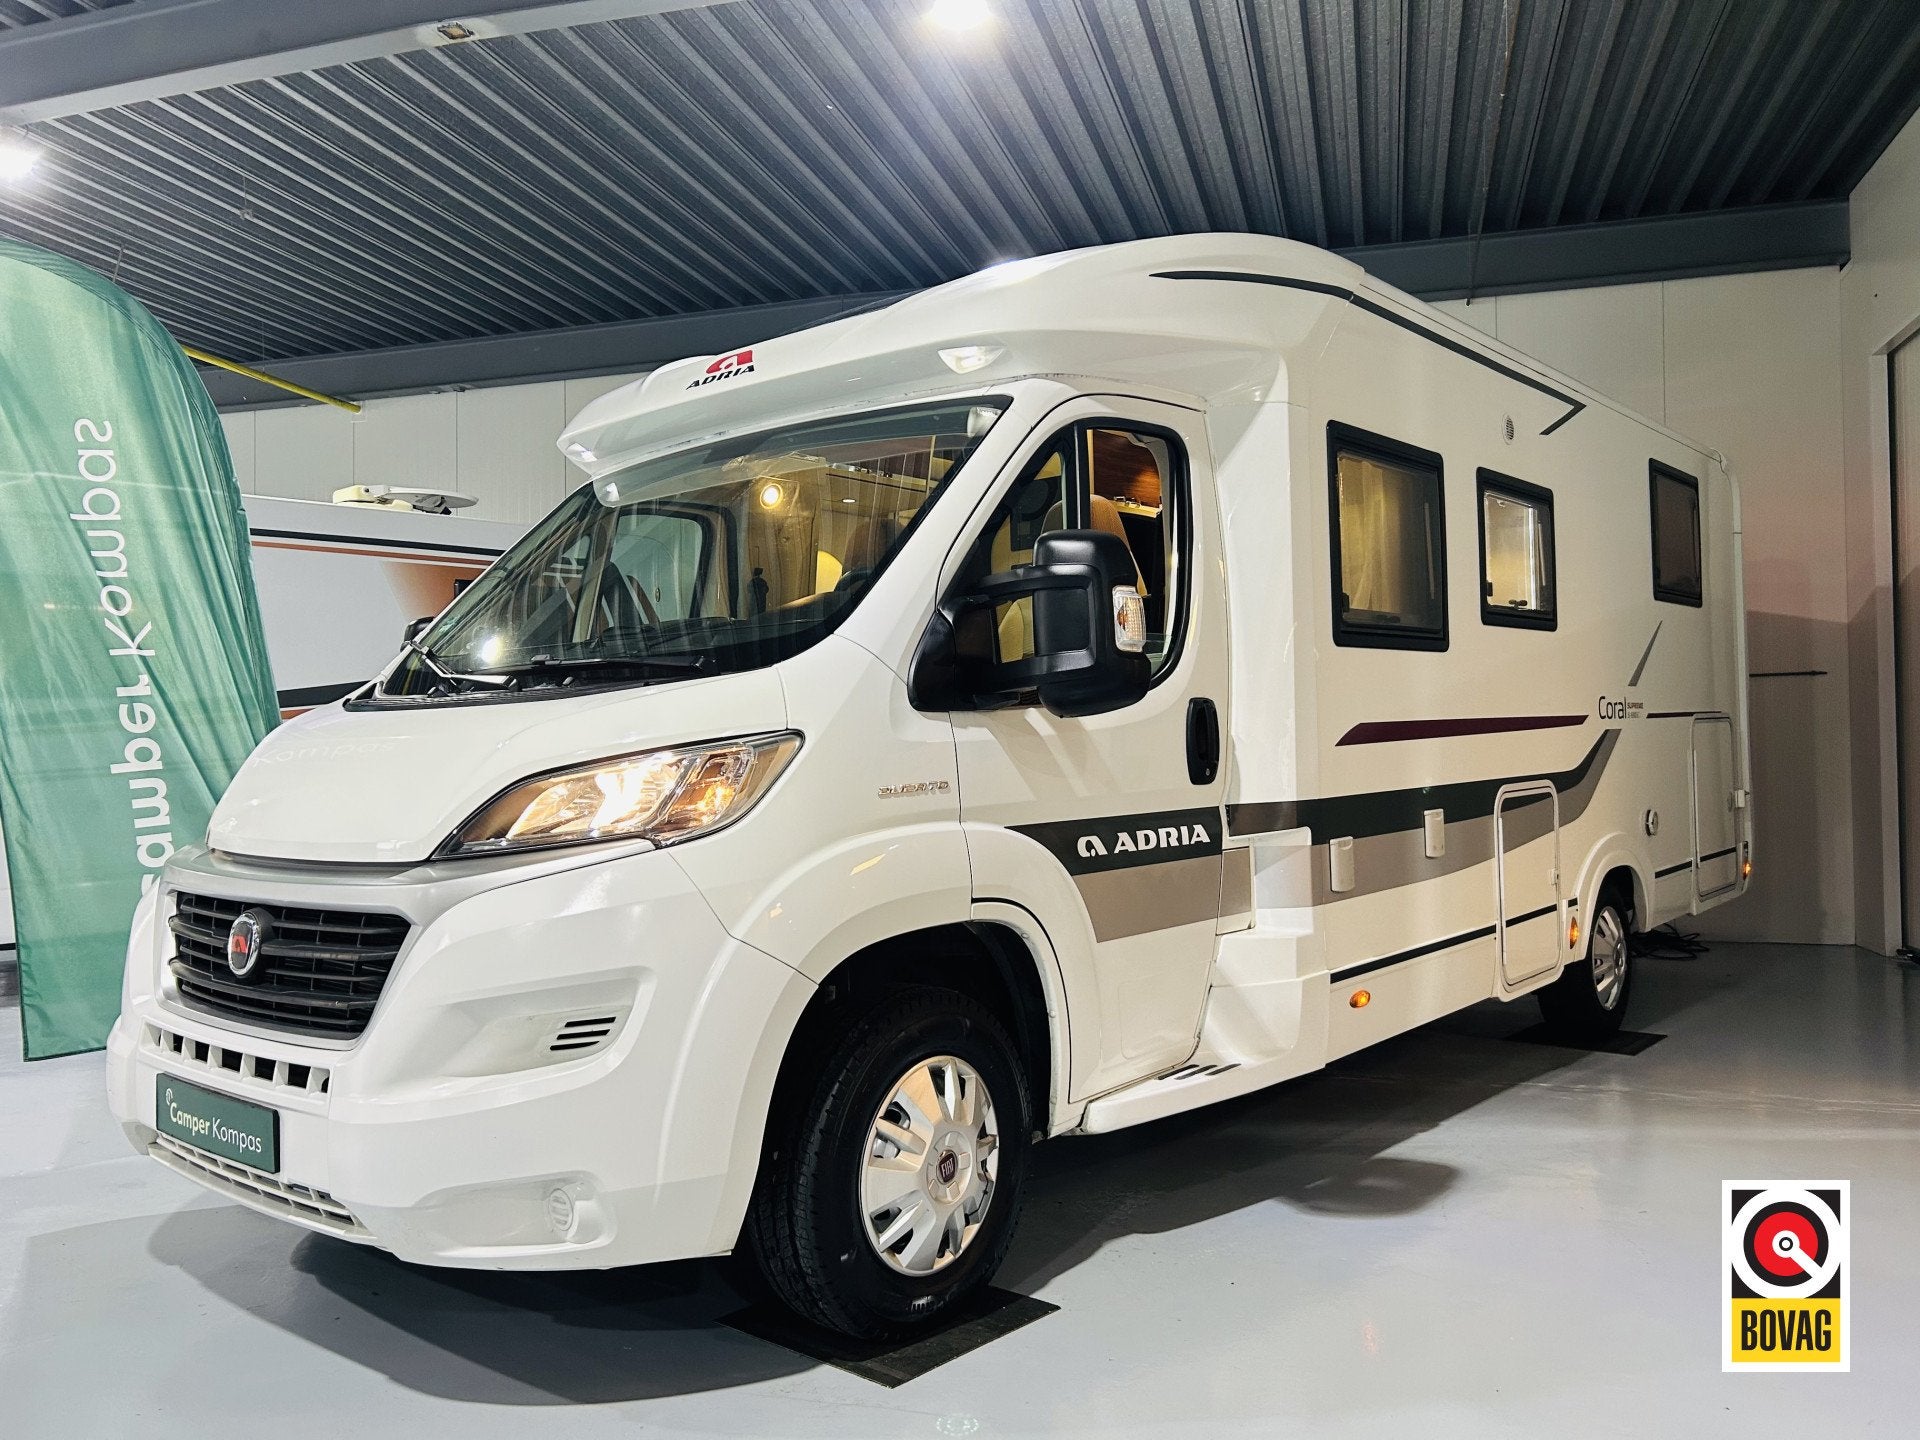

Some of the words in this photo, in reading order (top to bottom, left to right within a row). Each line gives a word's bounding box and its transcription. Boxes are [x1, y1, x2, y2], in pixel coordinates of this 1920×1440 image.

[686, 365, 755, 390] ADRIA
[1598, 696, 1627, 719] Coral
[1114, 824, 1211, 854] ADRIA
[170, 1102, 210, 1136] Camper
[212, 1117, 262, 1153] Kompas
[941, 1158, 954, 1178] FIAT
